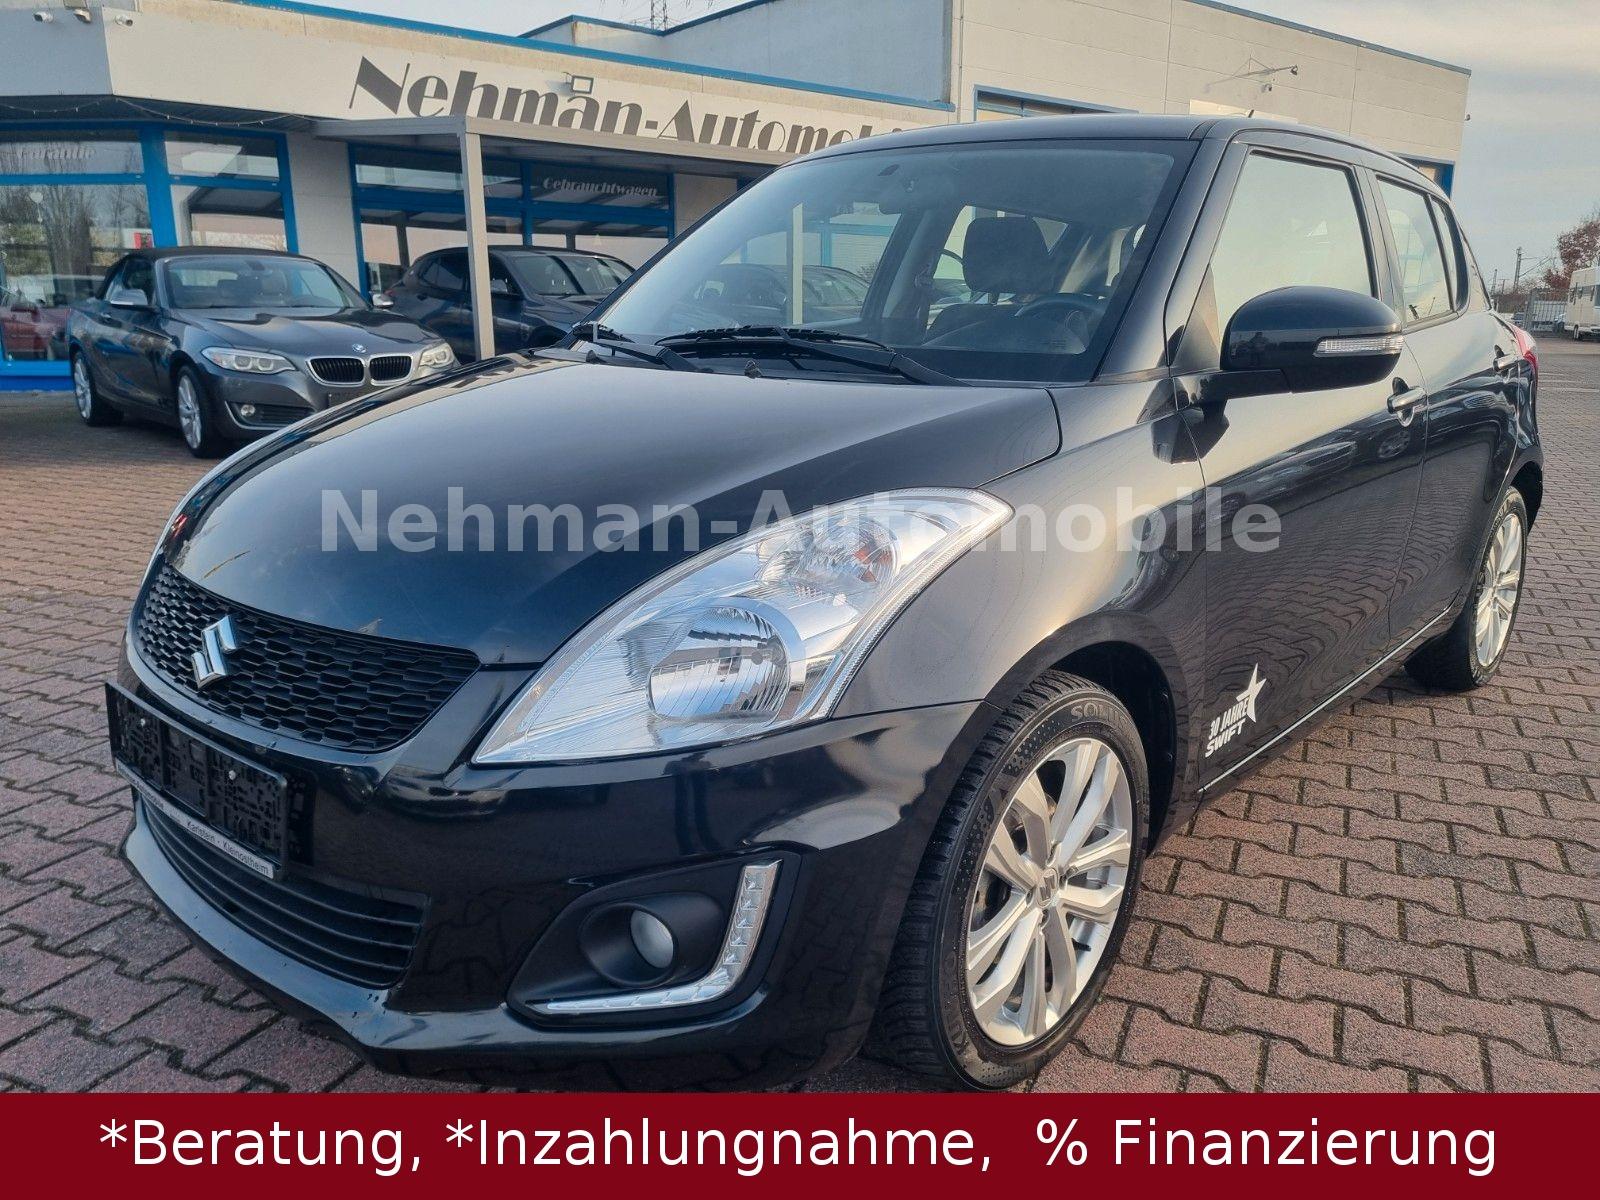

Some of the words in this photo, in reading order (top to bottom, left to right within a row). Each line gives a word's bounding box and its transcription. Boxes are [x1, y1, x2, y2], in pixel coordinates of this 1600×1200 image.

[349, 55, 903, 154] Nehman-Automo
[543, 178, 658, 197] Gebrauchtwagen
[1205, 718, 1246, 758] SWIFT
